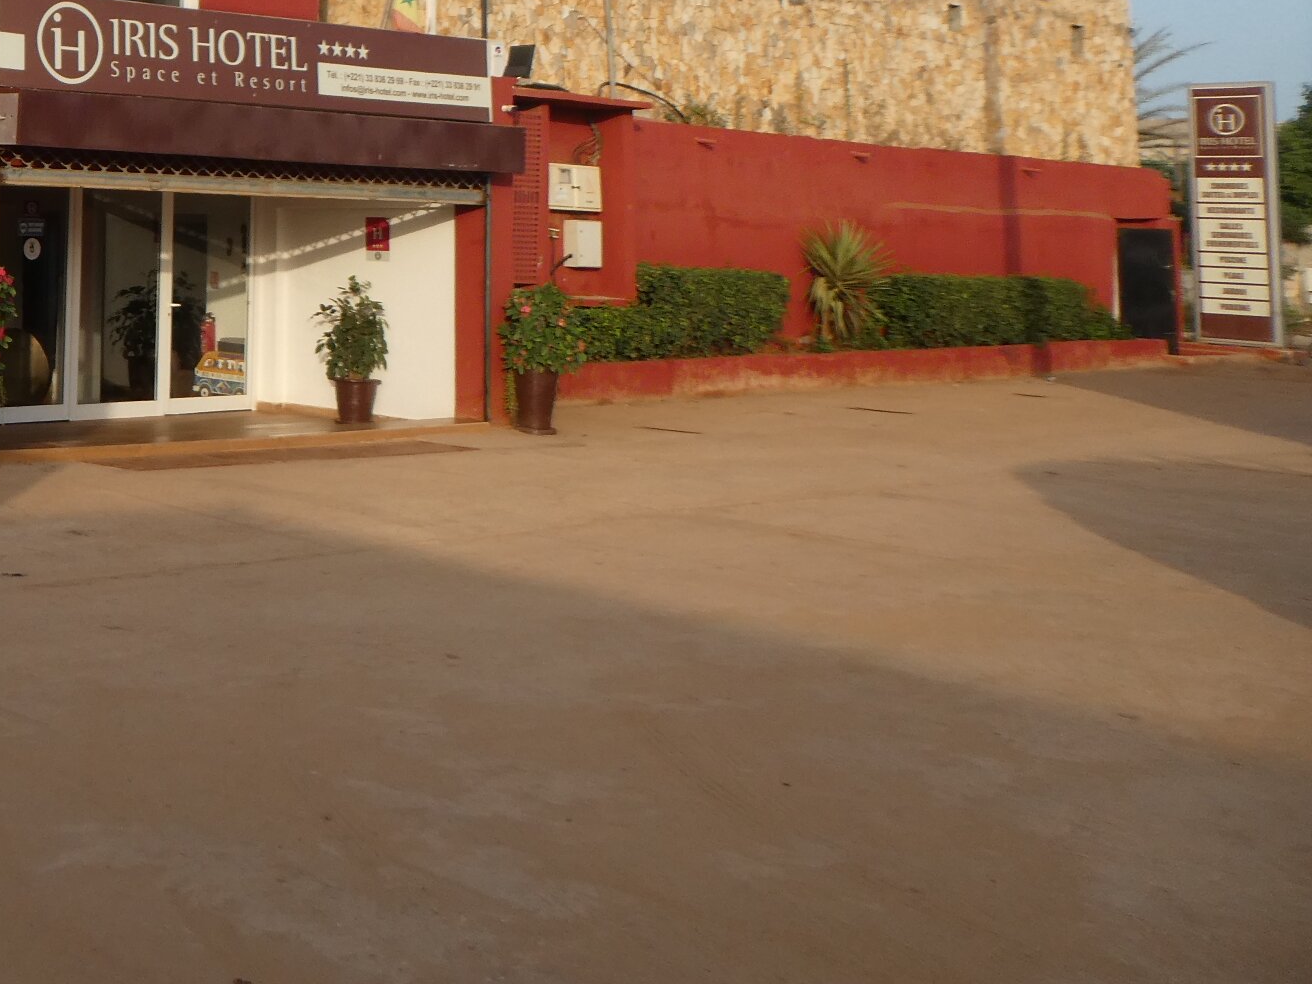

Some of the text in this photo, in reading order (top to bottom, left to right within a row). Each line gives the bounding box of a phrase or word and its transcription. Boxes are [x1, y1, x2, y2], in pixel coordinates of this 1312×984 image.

[109, 18, 309, 72] IRIS HOTEL
[110, 60, 307, 93] Space et Resort
[409, 78, 420, 86] Fax
[1220, 137, 1256, 146] HOTEL
